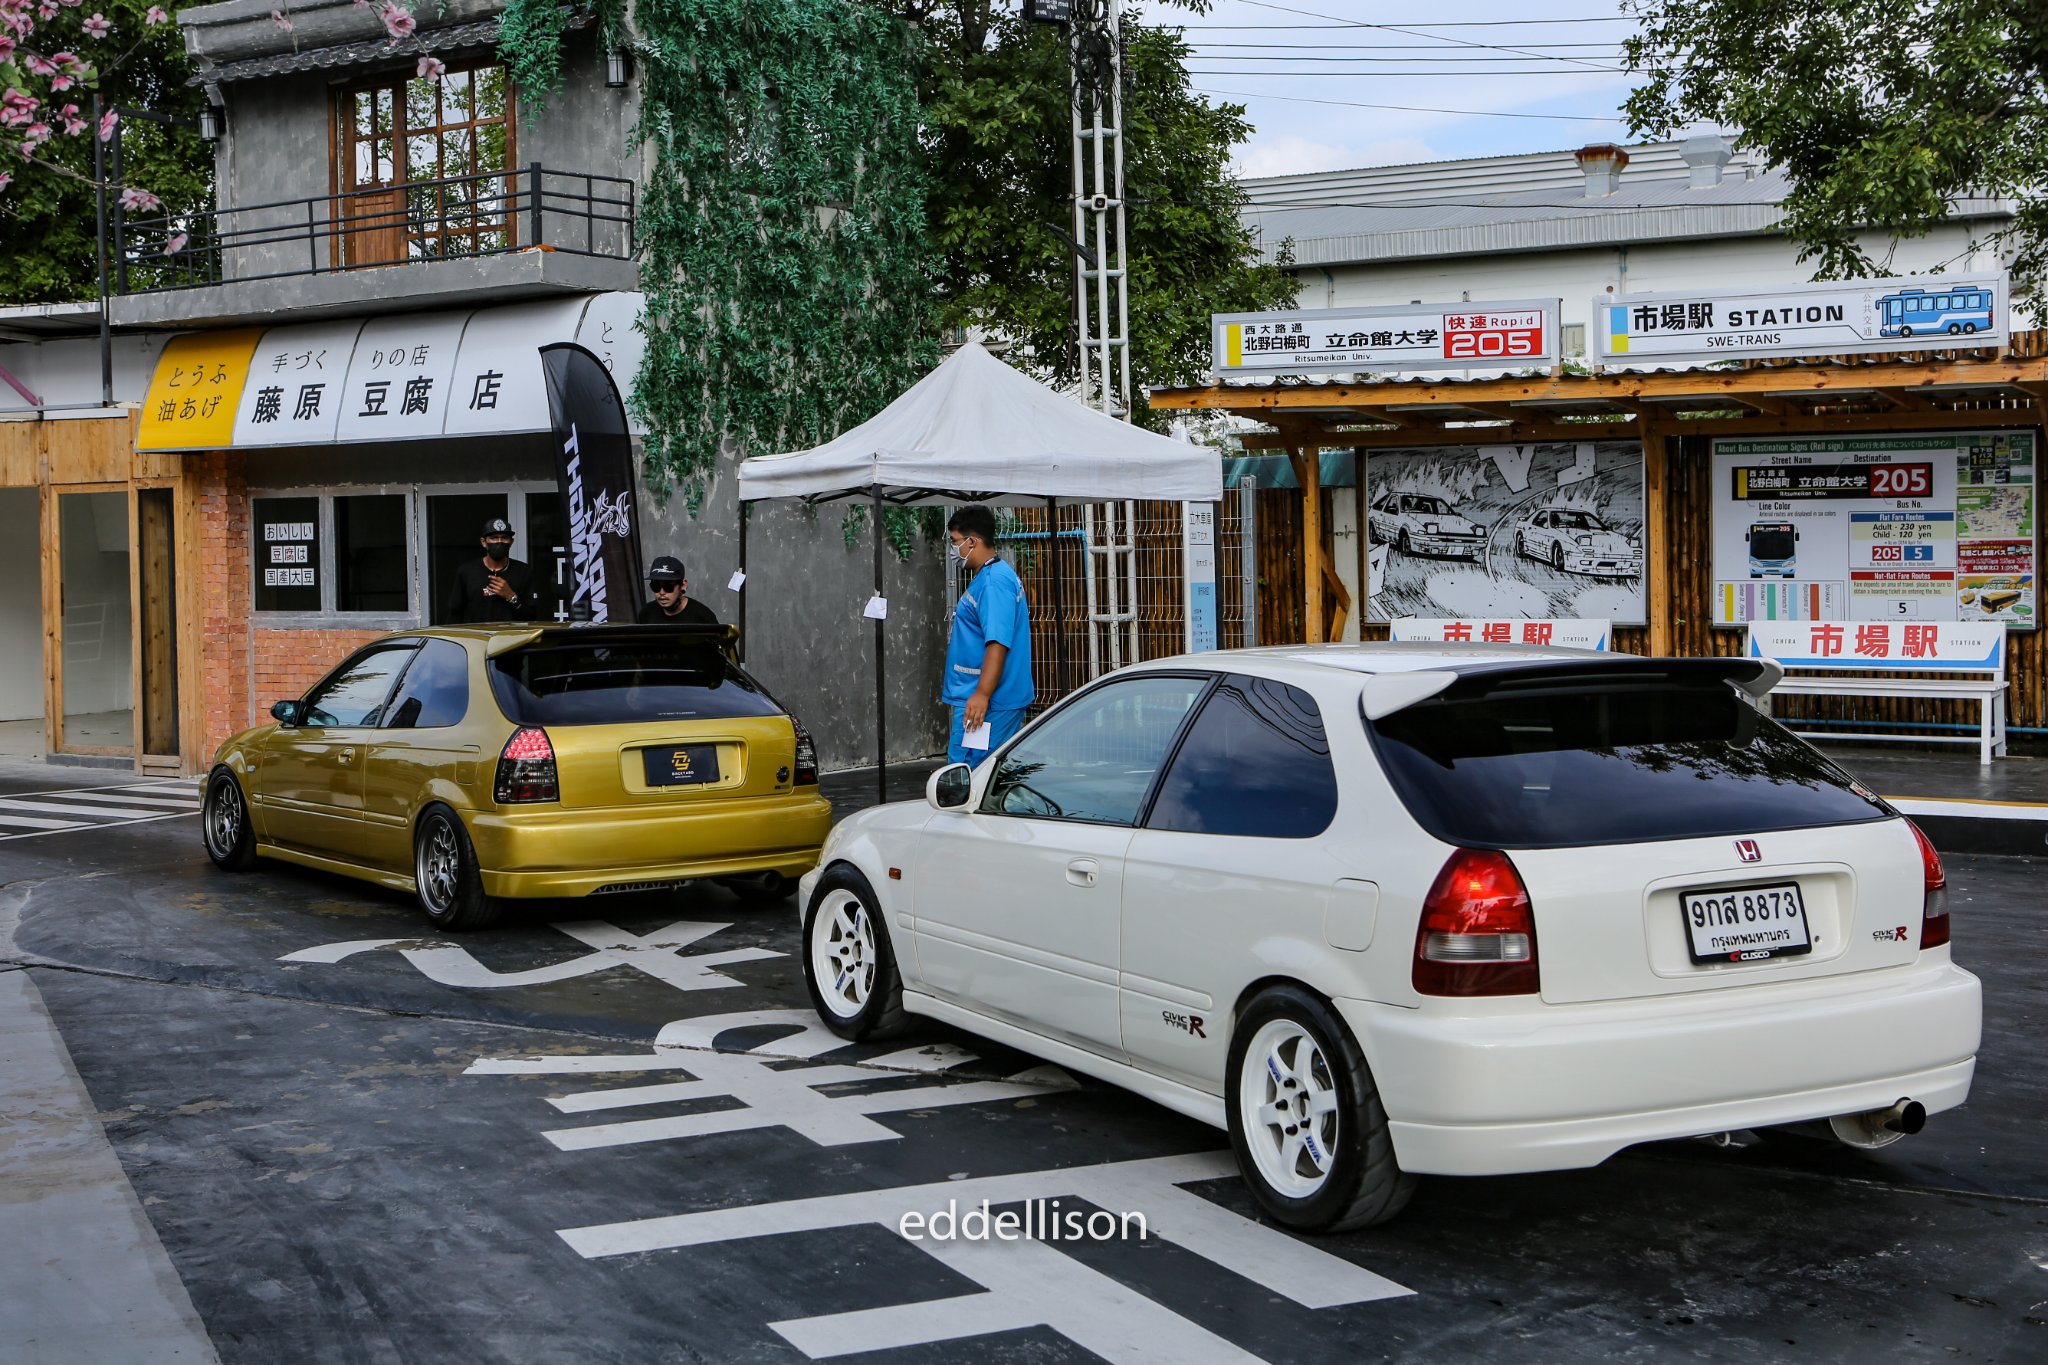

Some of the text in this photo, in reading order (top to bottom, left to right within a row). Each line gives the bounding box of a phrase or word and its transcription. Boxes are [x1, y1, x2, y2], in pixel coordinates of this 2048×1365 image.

[1448, 315, 1487, 330] 快速
[1491, 315, 1534, 330] Rapid
[1633, 302, 1713, 333] 市場駅
[1728, 304, 1844, 327] STATION
[1862, 293, 1873, 337] 公共交通
[1244, 322, 1303, 336] 西大路通
[1244, 335, 1311, 352] 北野白梅町
[1325, 328, 1439, 349] 立命館大学
[1450, 331, 1533, 357] 205
[1706, 333, 1782, 348] SWE-TRANS
[1294, 352, 1373, 363] Ritsumeikan Univ.
[168, 363, 228, 388] とうふ
[251, 369, 503, 424] 藤原豆腐店
[158, 395, 222, 422] 油あげ
[1771, 455, 1812, 464] Street Name
[1853, 454, 1891, 463] Destination
[1798, 476, 1867, 488] 立命館大学
[1873, 468, 1926, 492] 205
[1759, 502, 1791, 510] Line Color
[1896, 500, 1923, 509] Bus No.
[266, 525, 312, 539] おいしい
[1872, 523, 1932, 532] Adult 230 yen
[1872, 531, 1891, 539] Child
[1918, 532, 1932, 540] yen
[272, 547, 306, 561] 豆腐は
[1873, 547, 1900, 560] 205
[1914, 547, 1923, 559] 5
[1898, 602, 1907, 614] 5
[1444, 622, 1552, 646] 市場駅
[1810, 623, 1938, 658] 市場駅
[1692, 891, 1797, 928] 9กส 8873
[1711, 929, 1790, 952] กรุงเทพมหานคร
[1872, 929, 1895, 937] CIVIC
[1894, 926, 1908, 942] R
[1740, 950, 1770, 961] CUSCO
[1162, 1010, 1188, 1024] CIVIC
[1163, 1015, 1207, 1039] TYPE R
